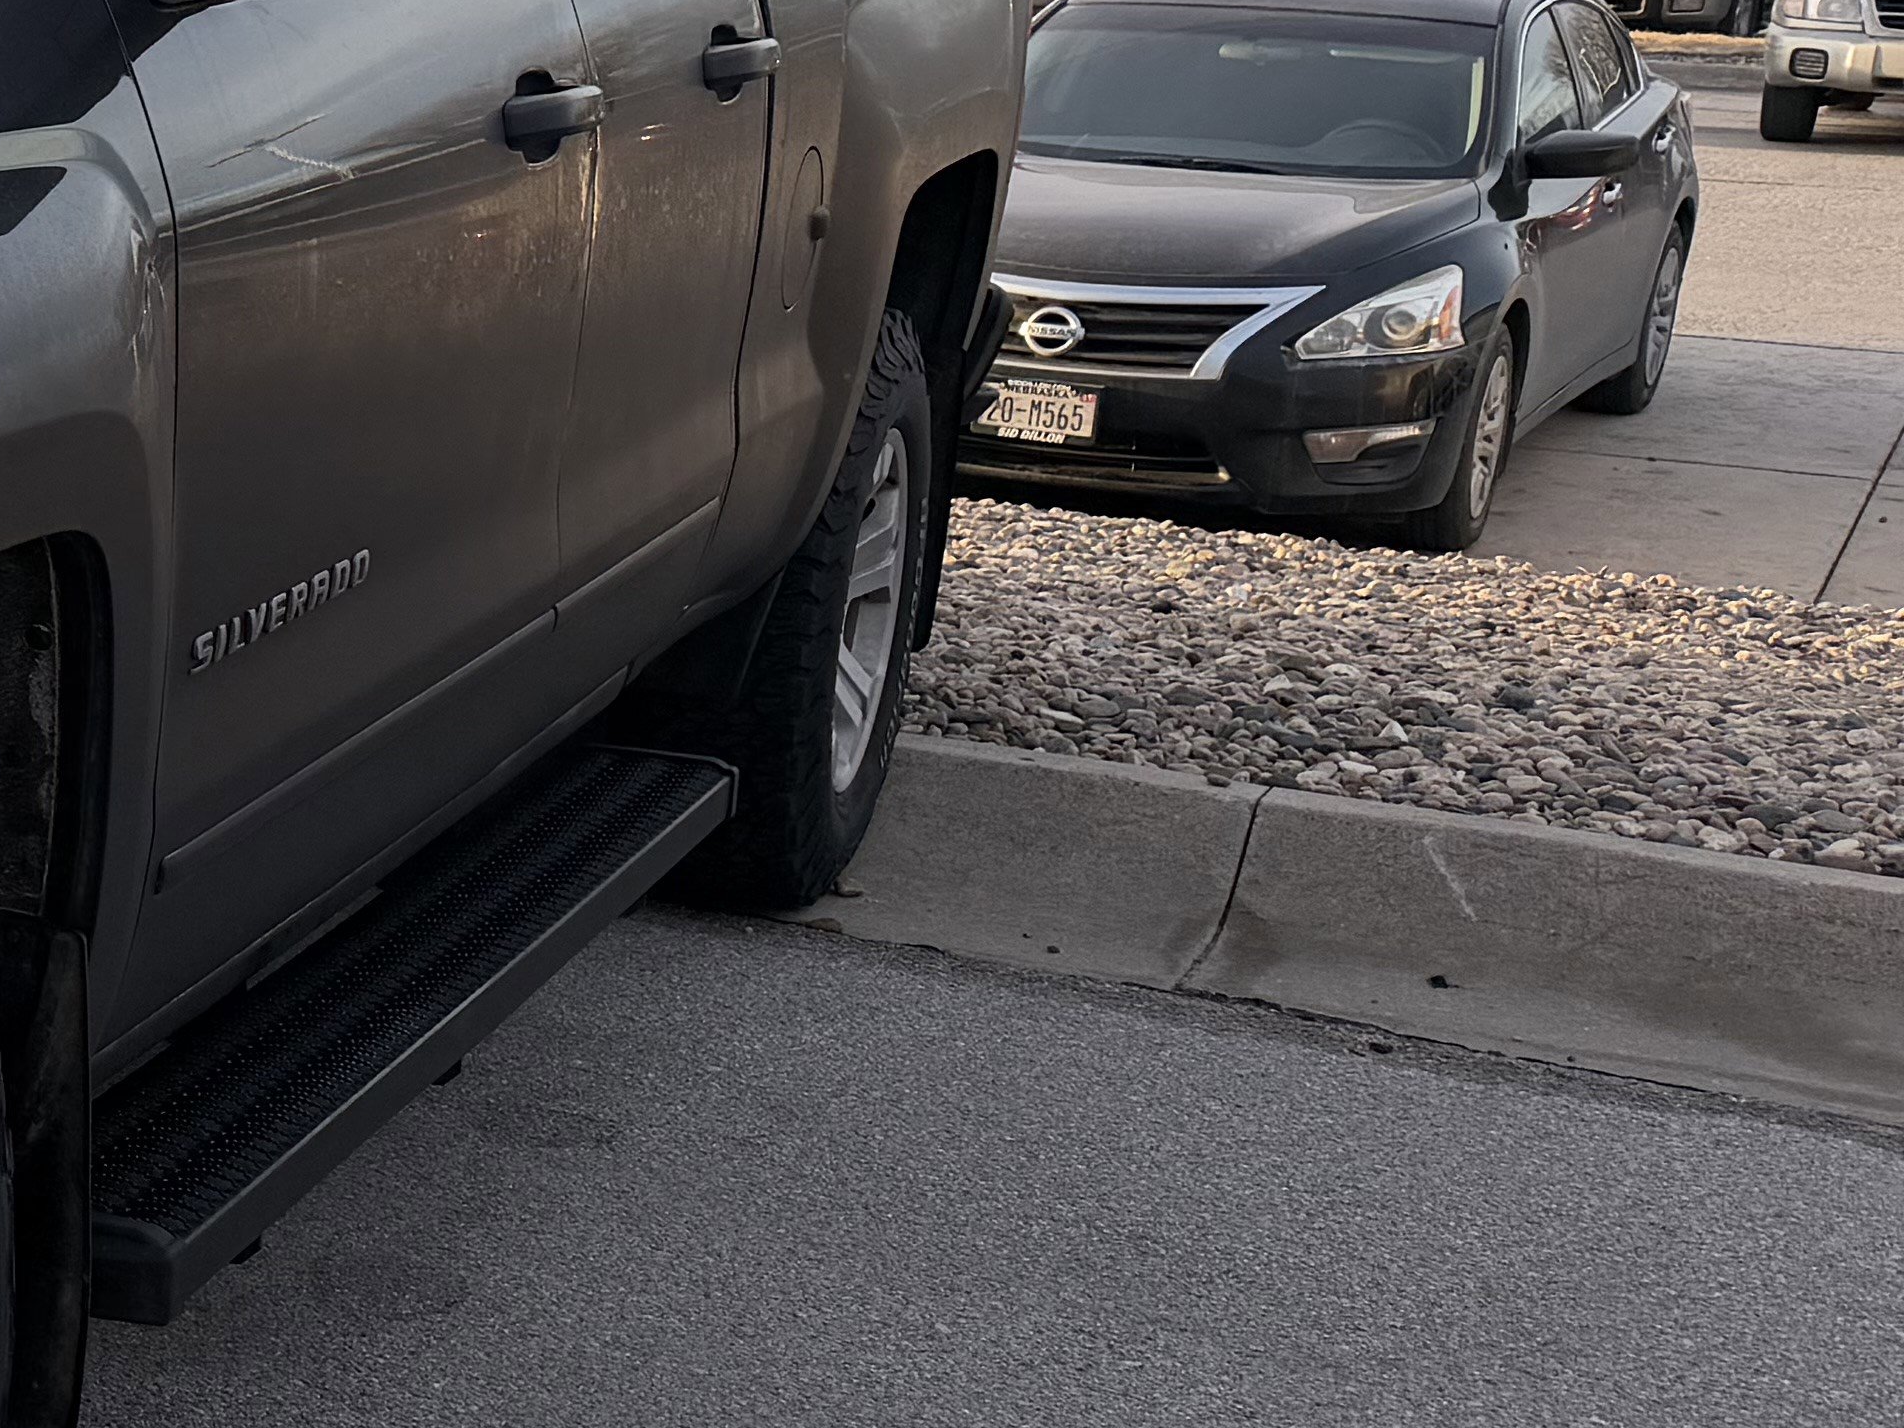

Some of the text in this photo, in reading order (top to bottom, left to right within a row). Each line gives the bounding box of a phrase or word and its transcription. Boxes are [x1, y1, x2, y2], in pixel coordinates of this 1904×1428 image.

[1028, 325, 1076, 337] NISSAN
[1020, 429, 1066, 444] DILLON
[189, 547, 371, 674] SILVERADO
